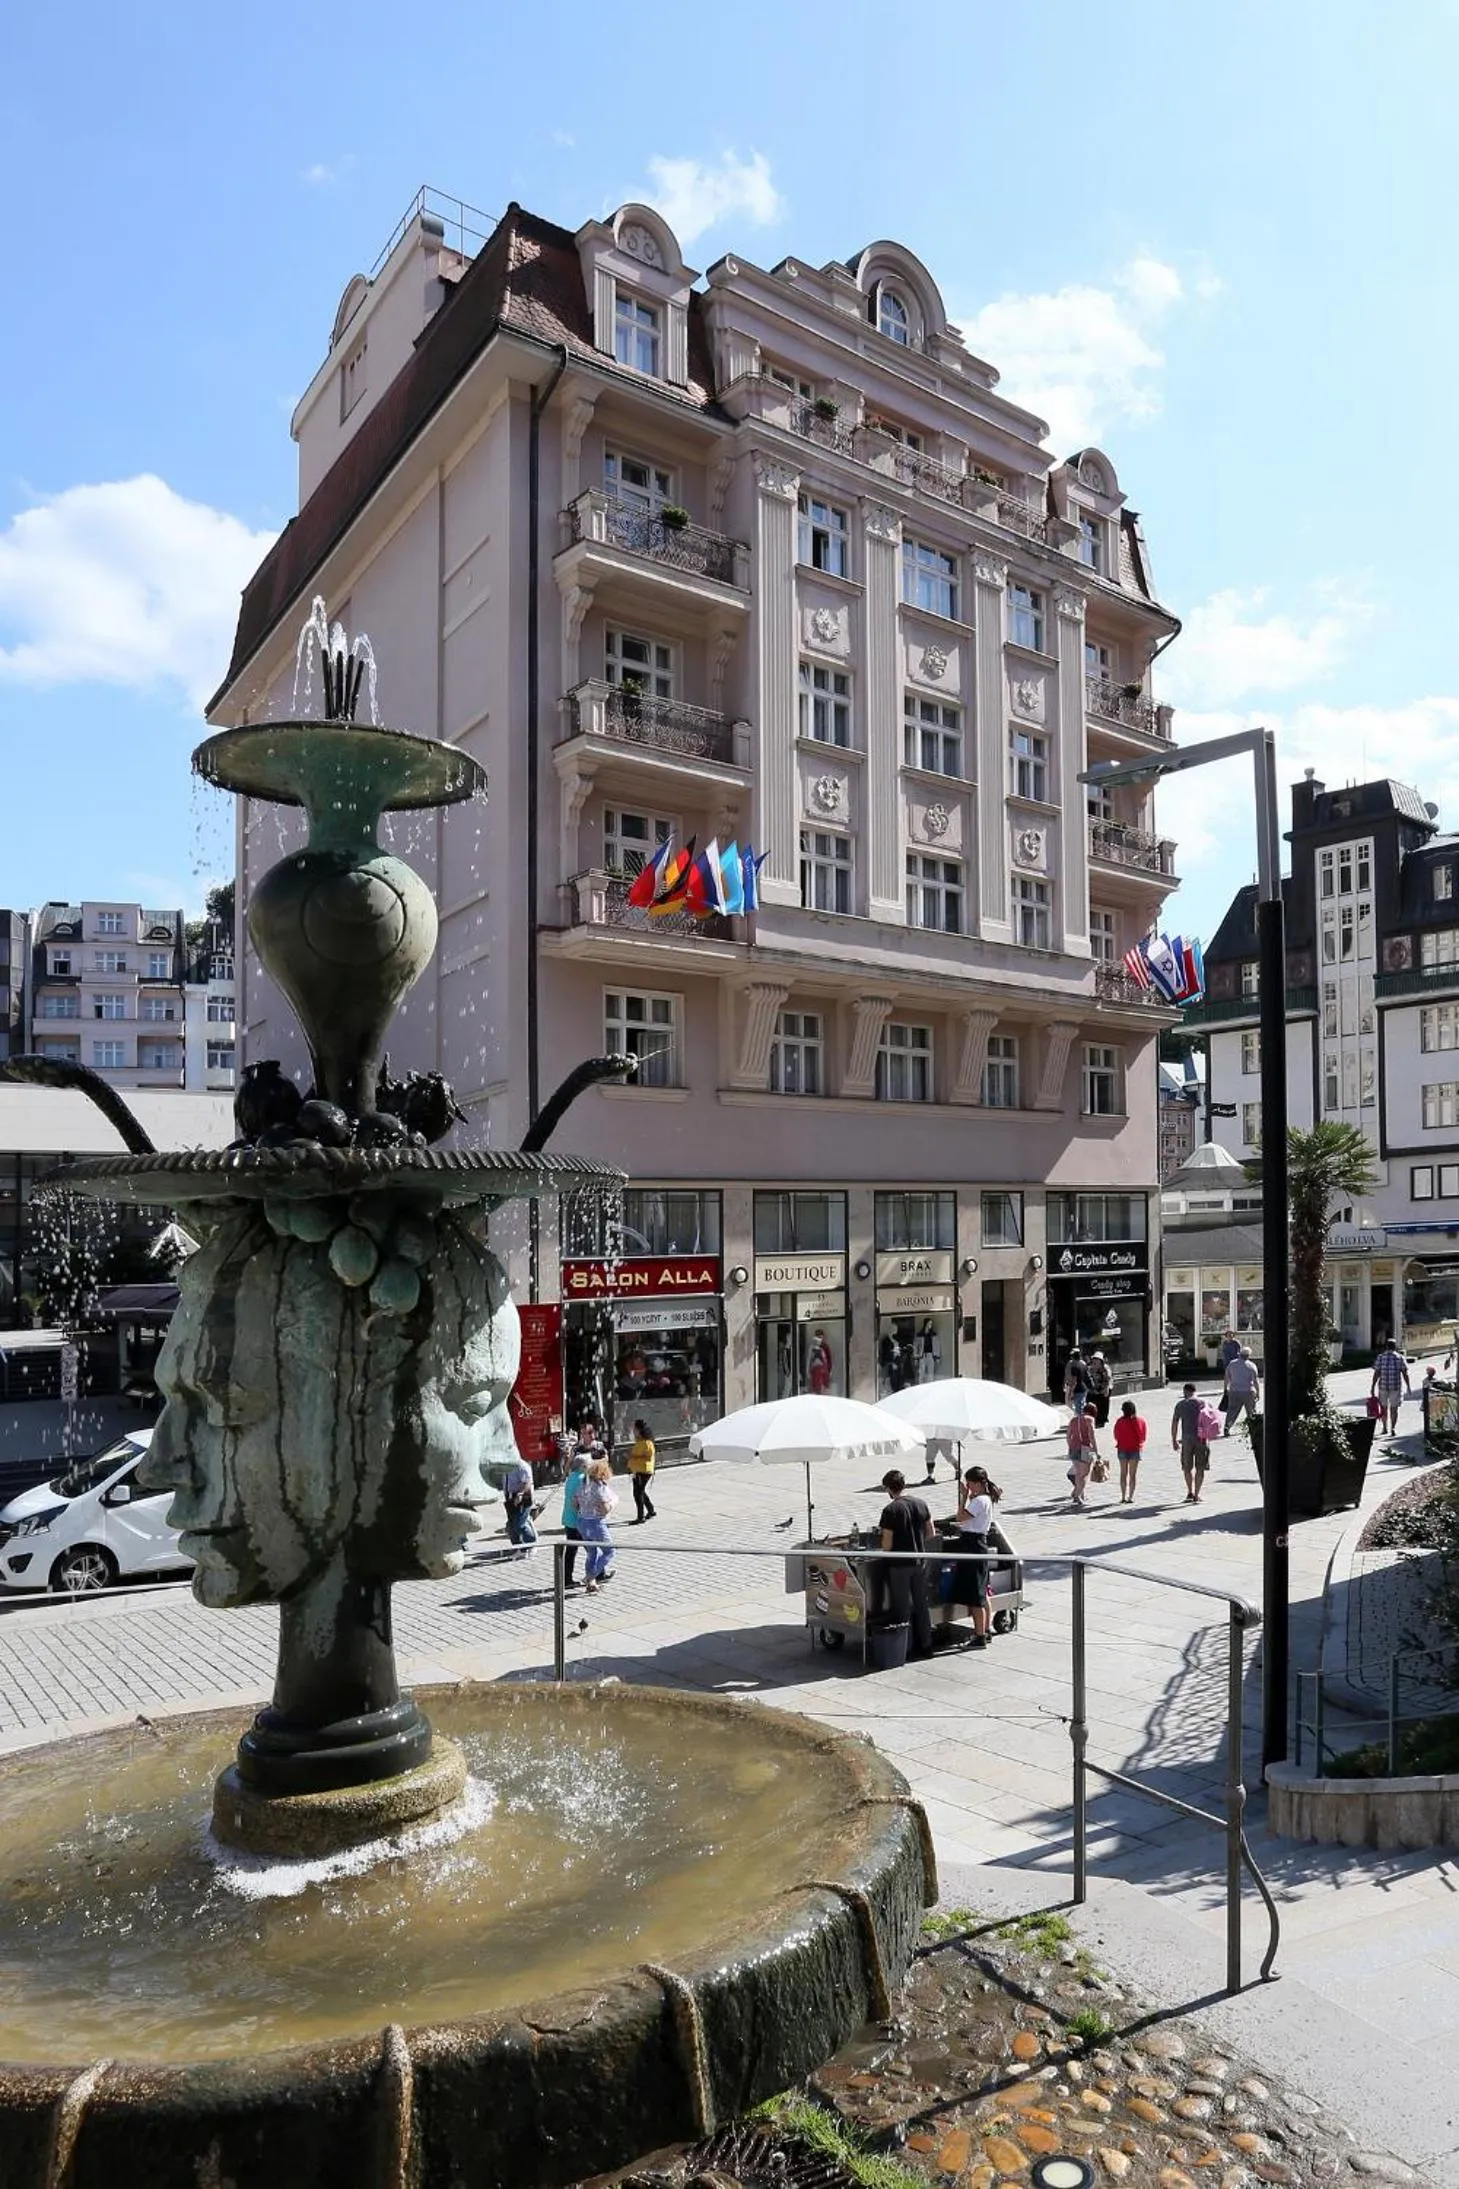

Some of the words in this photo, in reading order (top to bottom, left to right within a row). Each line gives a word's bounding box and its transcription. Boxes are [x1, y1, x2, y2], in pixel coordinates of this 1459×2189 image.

[900, 1260, 932, 1272] BRAX
[1074, 1253, 1108, 1269] Captain
[1110, 1252, 1136, 1267] Candy
[570, 1272, 648, 1288] SALON
[658, 1269, 713, 1285] ALLA
[765, 1266, 836, 1281] BOUTIQUE
